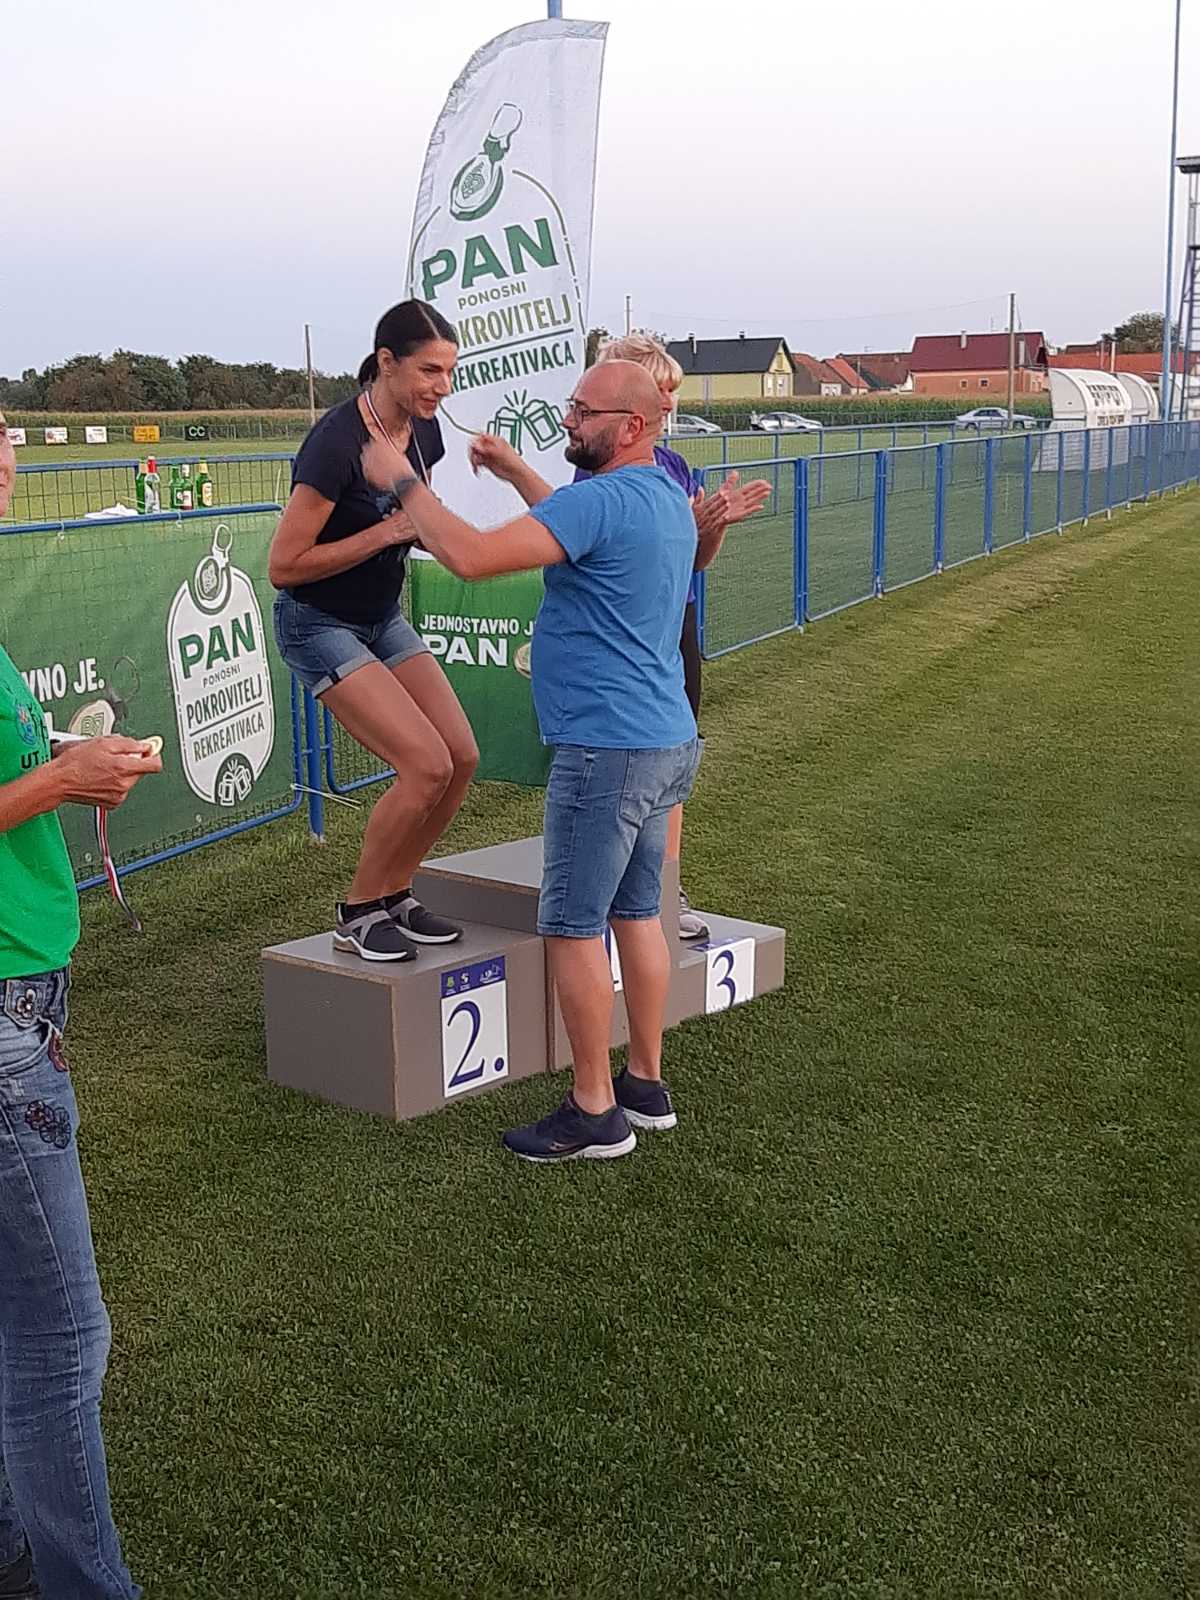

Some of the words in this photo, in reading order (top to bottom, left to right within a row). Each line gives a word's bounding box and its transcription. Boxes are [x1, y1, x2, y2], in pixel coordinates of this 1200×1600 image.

[422, 217, 559, 301] PAN
[455, 294, 572, 349] KROVITELJ
[457, 280, 528, 311] PONOSNI
[178, 612, 257, 680] PAN
[420, 614, 519, 635] JEDNOSTAVNO
[422, 633, 508, 667] PAN
[73, 658, 105, 694] JE.
[186, 673, 263, 729] POKROVITELJ
[202, 663, 241, 689] PONOSNI
[193, 711, 265, 763] REKREATIVACA
[447, 1000, 505, 1089] 2.
